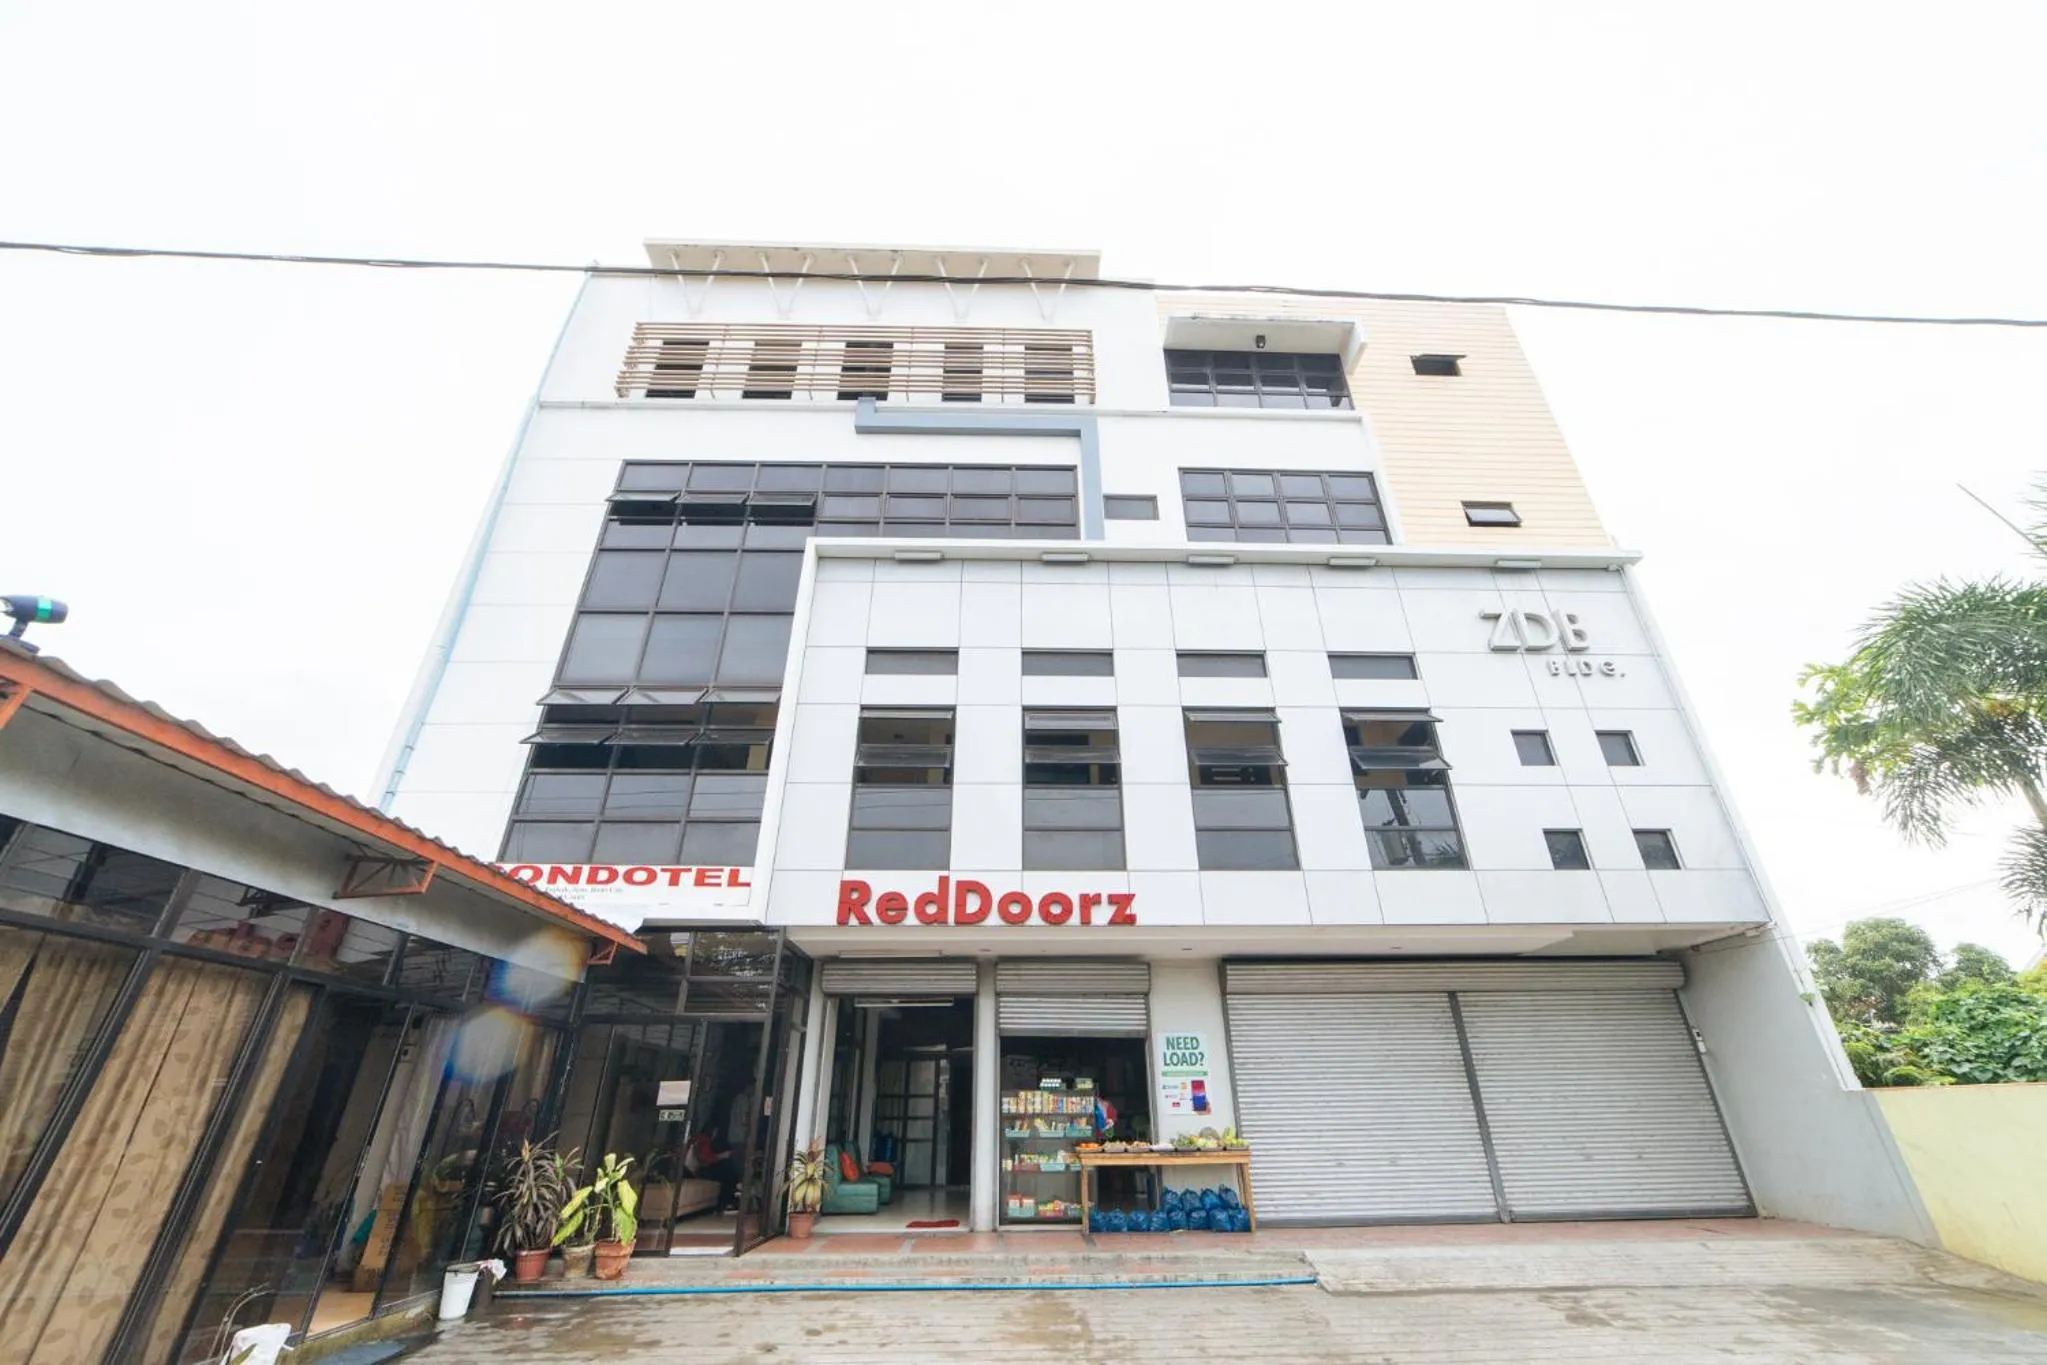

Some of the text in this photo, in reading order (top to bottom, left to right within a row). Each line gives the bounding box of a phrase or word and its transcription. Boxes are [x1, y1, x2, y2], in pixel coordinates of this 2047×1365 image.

[498, 865, 751, 888] ONDOTEL
[837, 875, 1136, 926] RedDoorz
[1166, 1036, 1199, 1050] NEED
[1164, 1052, 1205, 1066] LOAD?
